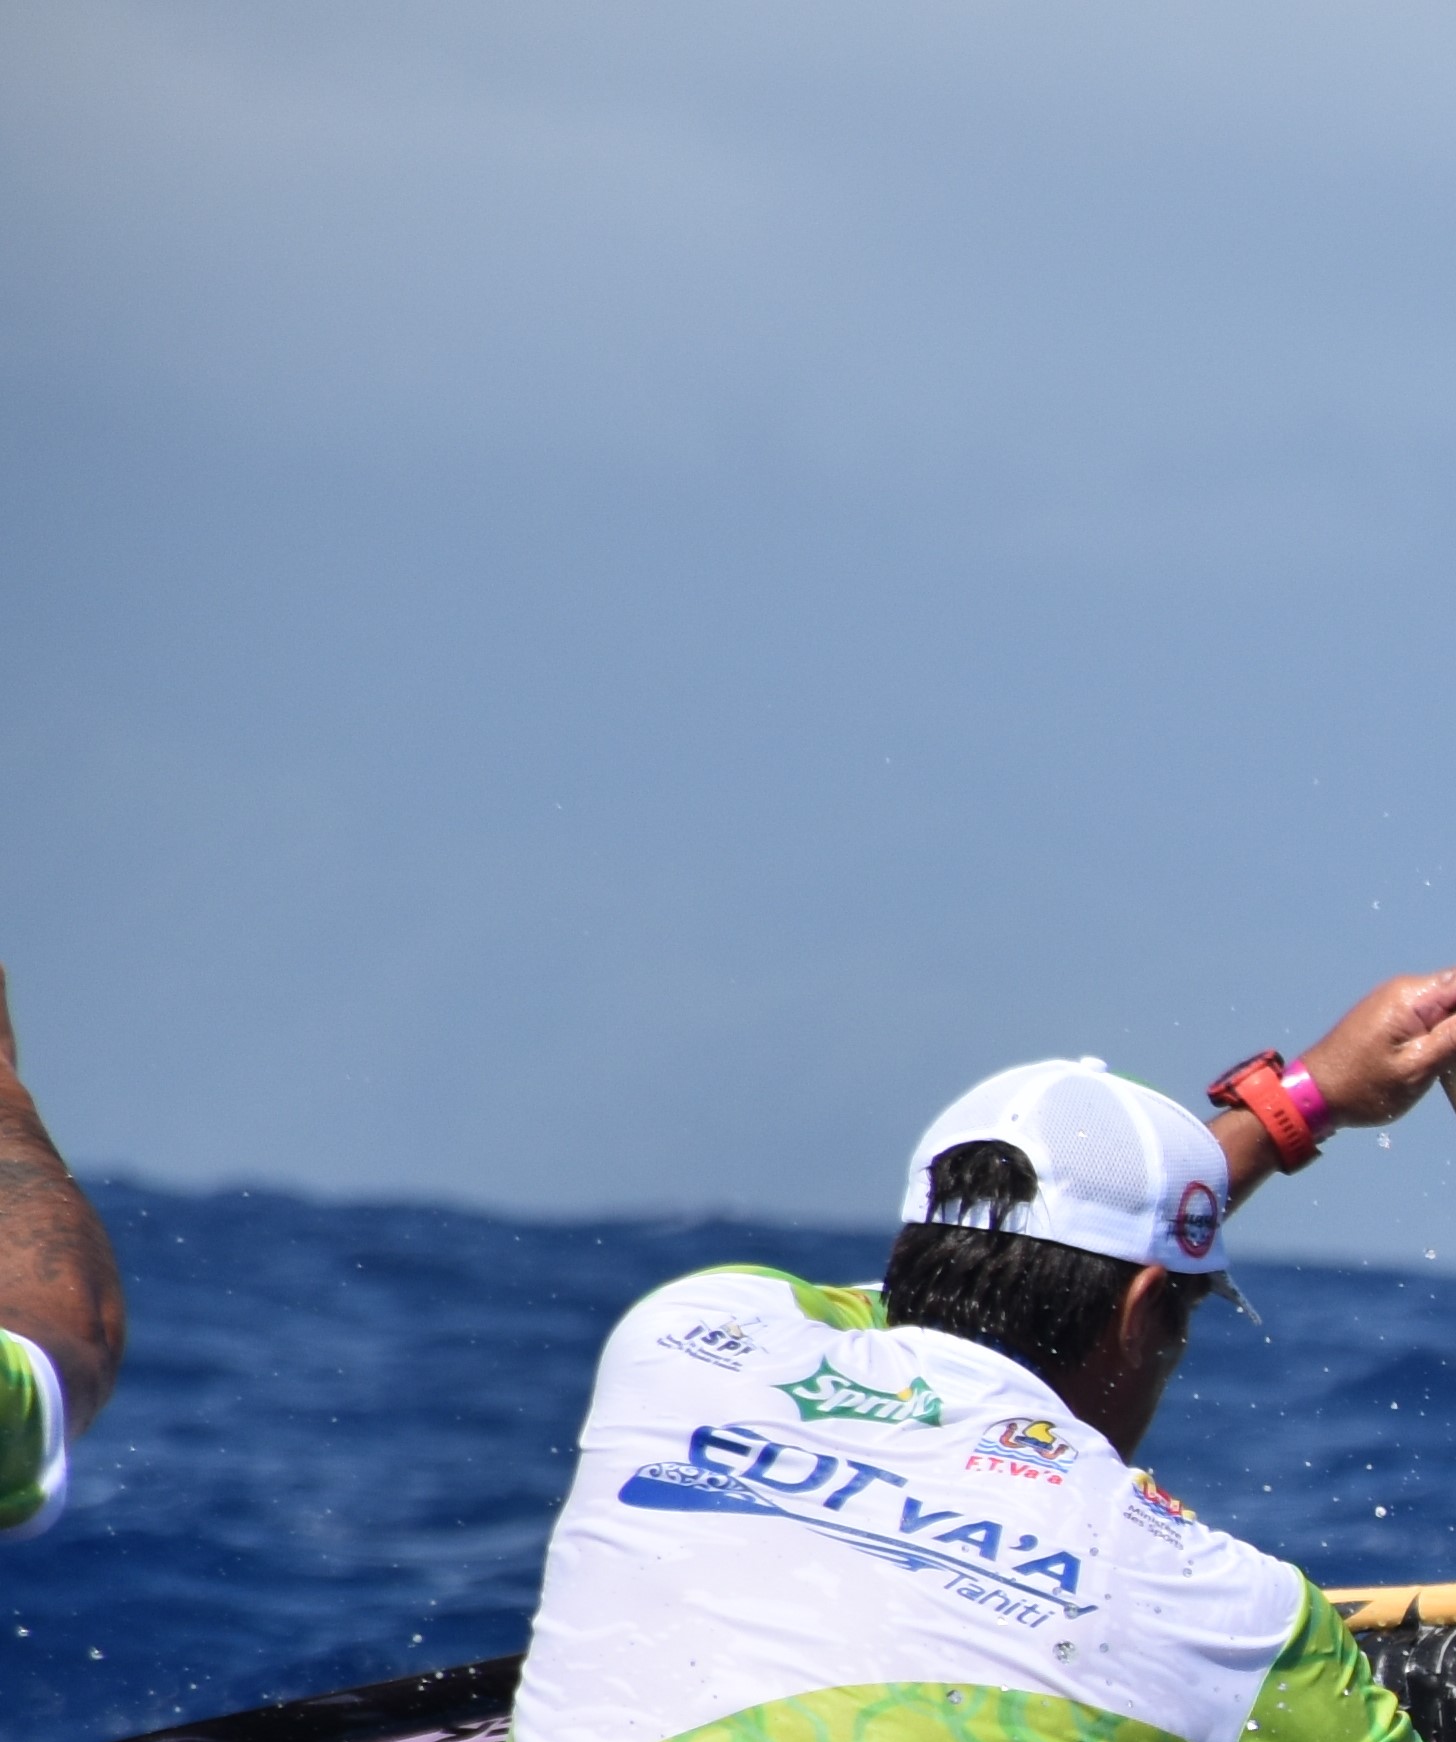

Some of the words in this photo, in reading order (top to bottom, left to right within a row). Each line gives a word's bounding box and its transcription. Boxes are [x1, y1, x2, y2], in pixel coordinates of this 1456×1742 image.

[965, 1455, 1063, 1486] F.T.Va'a
[688, 1424, 909, 1511] EDT
[899, 1497, 1082, 1594] VA'A
[1123, 1512, 1144, 1527] des
[943, 1569, 1054, 1628] Tahiti
